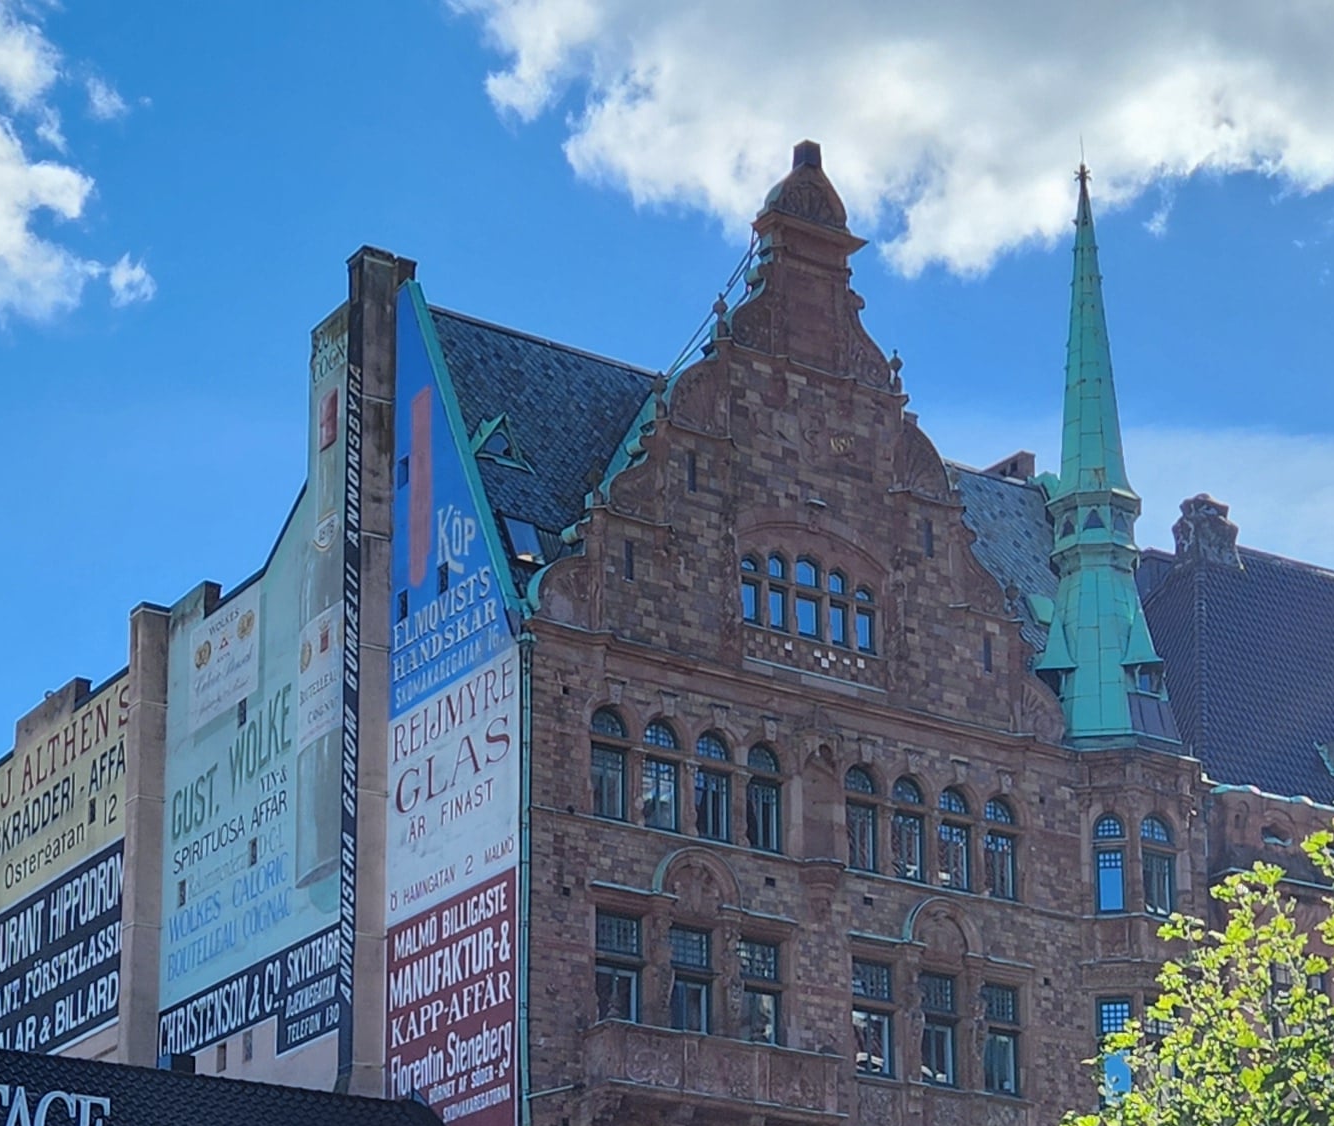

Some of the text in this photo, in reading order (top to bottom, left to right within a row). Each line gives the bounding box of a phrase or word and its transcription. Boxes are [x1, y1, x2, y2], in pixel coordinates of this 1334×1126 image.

[437, 504, 476, 575] KÖP
[393, 597, 497, 684] HANDSKAR
[393, 657, 515, 765] REIJMYRE
[0, 768, 15, 808] J.
[172, 763, 219, 841] GUST.
[229, 683, 292, 798] WOLKE
[342, 704, 358, 818] GENOM
[395, 714, 511, 815] GLAS
[4, 793, 117, 890] Östergatan 12
[173, 789, 288, 875] SPIRITUOSA AFFÄR
[408, 777, 494, 844] ÄR FINAST
[168, 852, 288, 944] WOLKES CALORIC
[403, 864, 456, 907] HAMNGATAN
[465, 854, 473, 876] 2
[484, 834, 515, 865] MALMÖ
[242, 887, 293, 938] COGNAC
[339, 831, 355, 1005] ANNONSERA
[394, 881, 508, 962] MALMÖ BILLIGASTE
[39, 1014, 52, 1044] &
[54, 970, 119, 1037] BILLARD
[159, 974, 248, 1057] CHRISTENSON
[248, 974, 260, 1020] &
[287, 1003, 340, 1045] TELEFON 130
[391, 970, 512, 1049] KAPP-AFFÄR
[391, 1020, 513, 1101] Florentin Steneberg
